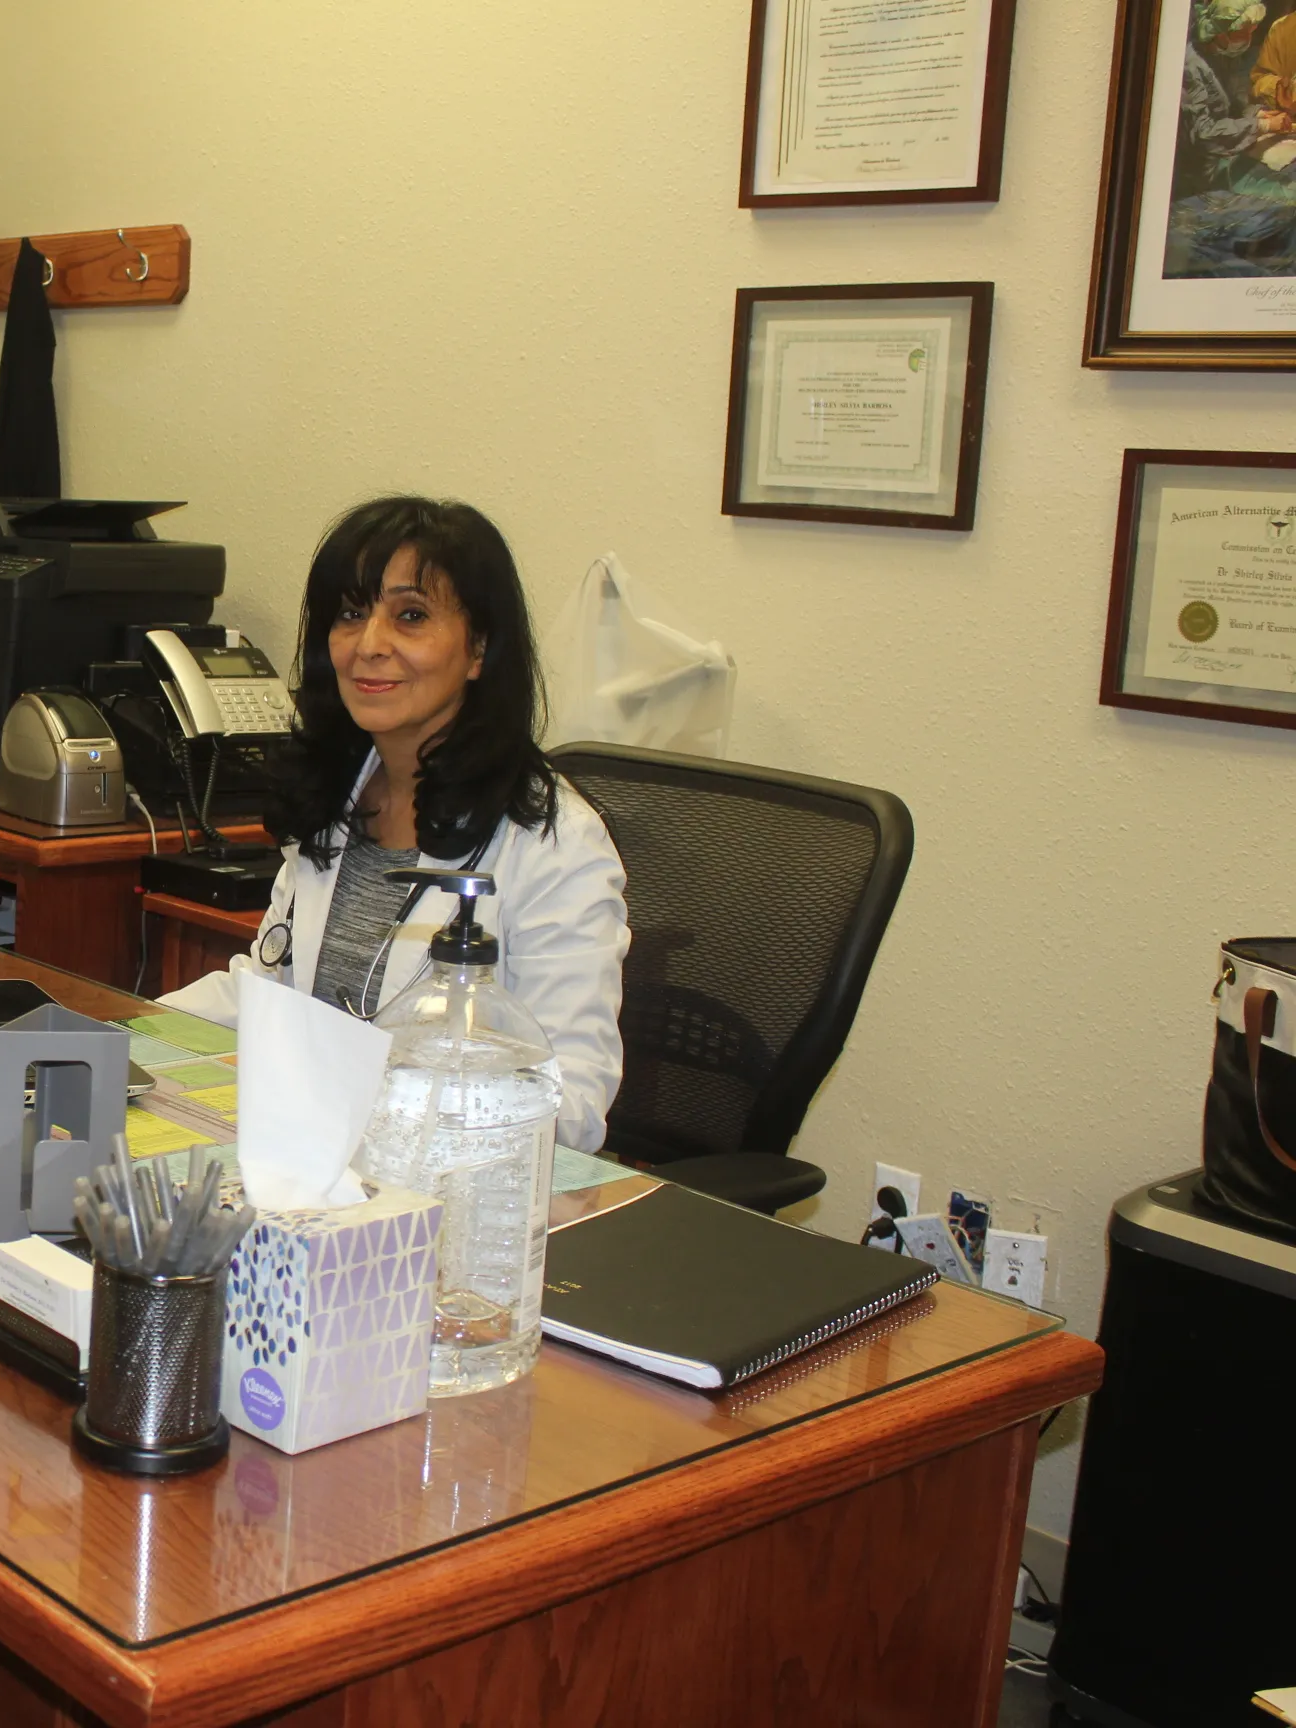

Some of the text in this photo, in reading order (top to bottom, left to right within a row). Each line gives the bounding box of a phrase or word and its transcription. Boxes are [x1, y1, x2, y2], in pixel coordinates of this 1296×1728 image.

[1170, 509, 1219, 525] American
[1223, 505, 1281, 516] Alternative
[1221, 541, 1270, 553] Commission
[1233, 568, 1264, 581] Shirley
[1229, 618, 1265, 631] Board of
[243, 1377, 282, 1405] Kleenex
